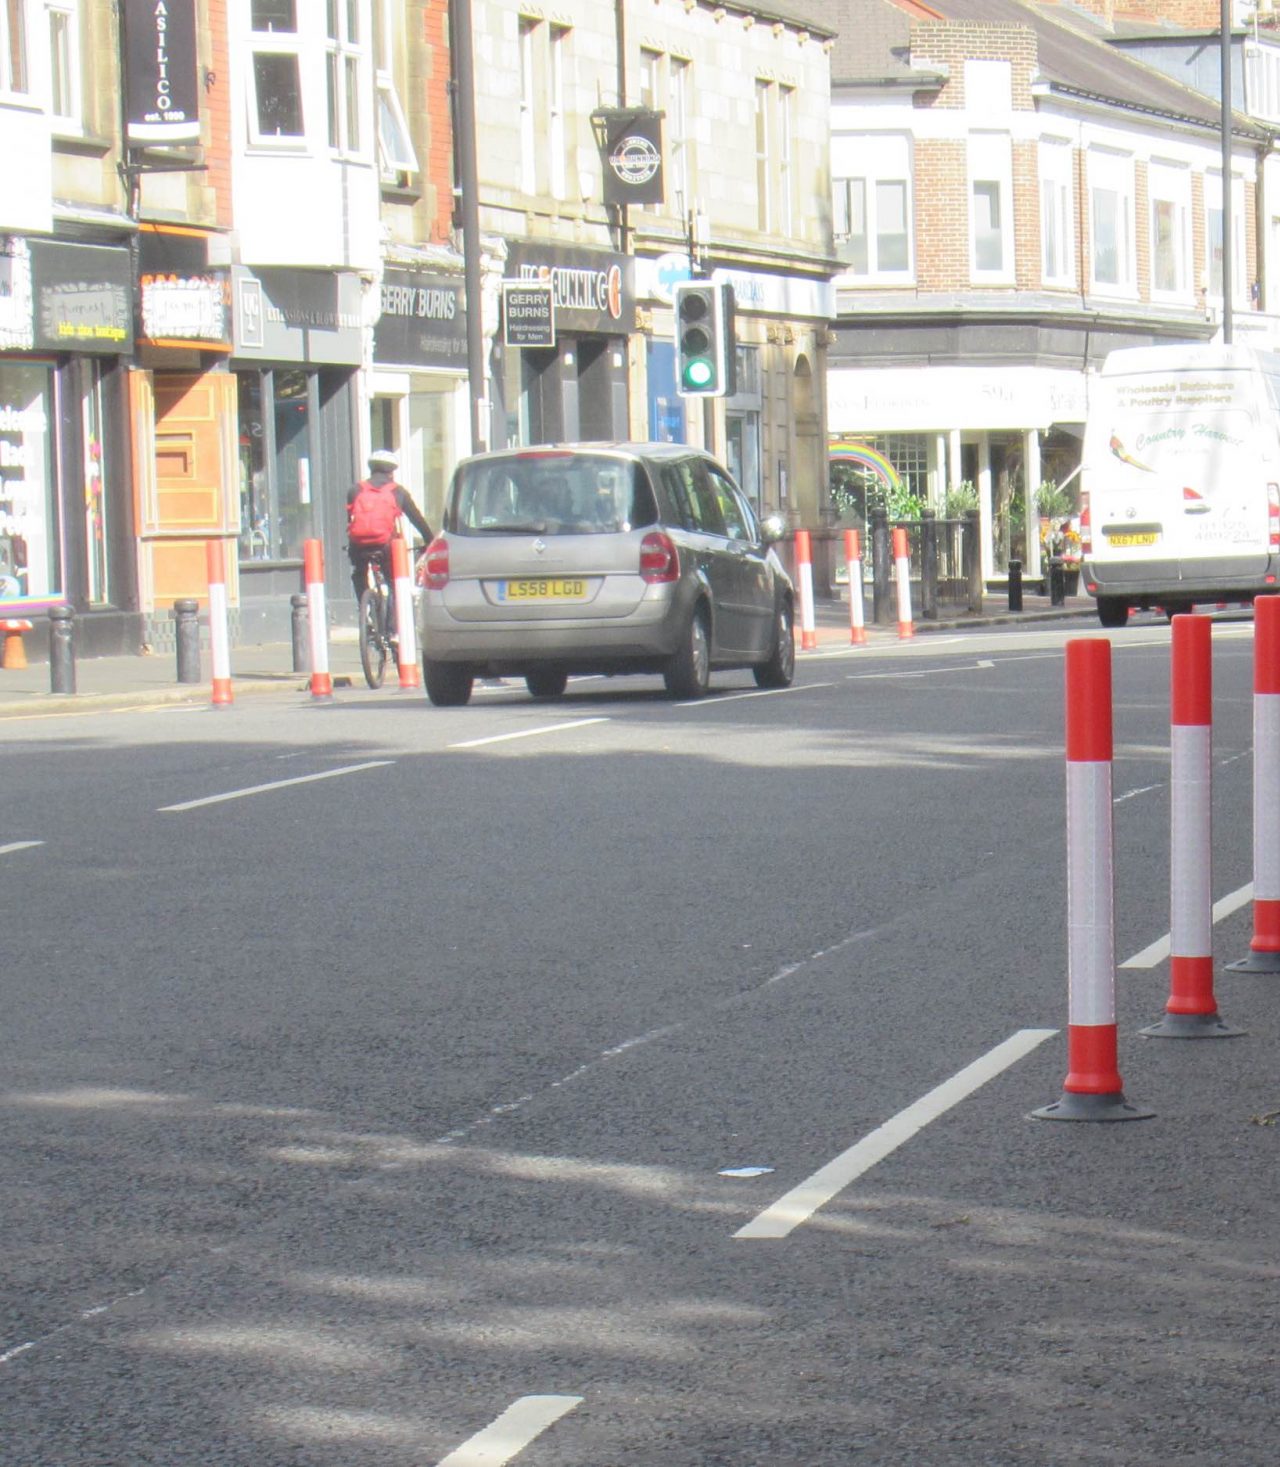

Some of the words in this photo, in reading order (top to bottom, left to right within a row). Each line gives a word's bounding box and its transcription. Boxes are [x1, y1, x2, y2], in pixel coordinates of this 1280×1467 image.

[381, 286, 416, 316] GERRY
[418, 289, 456, 319] BURNS
[508, 294, 549, 305] GERRY
[508, 307, 549, 318] BURNS
[1130, 397, 1172, 407] Poultry
[508, 581, 548, 597] LS58
